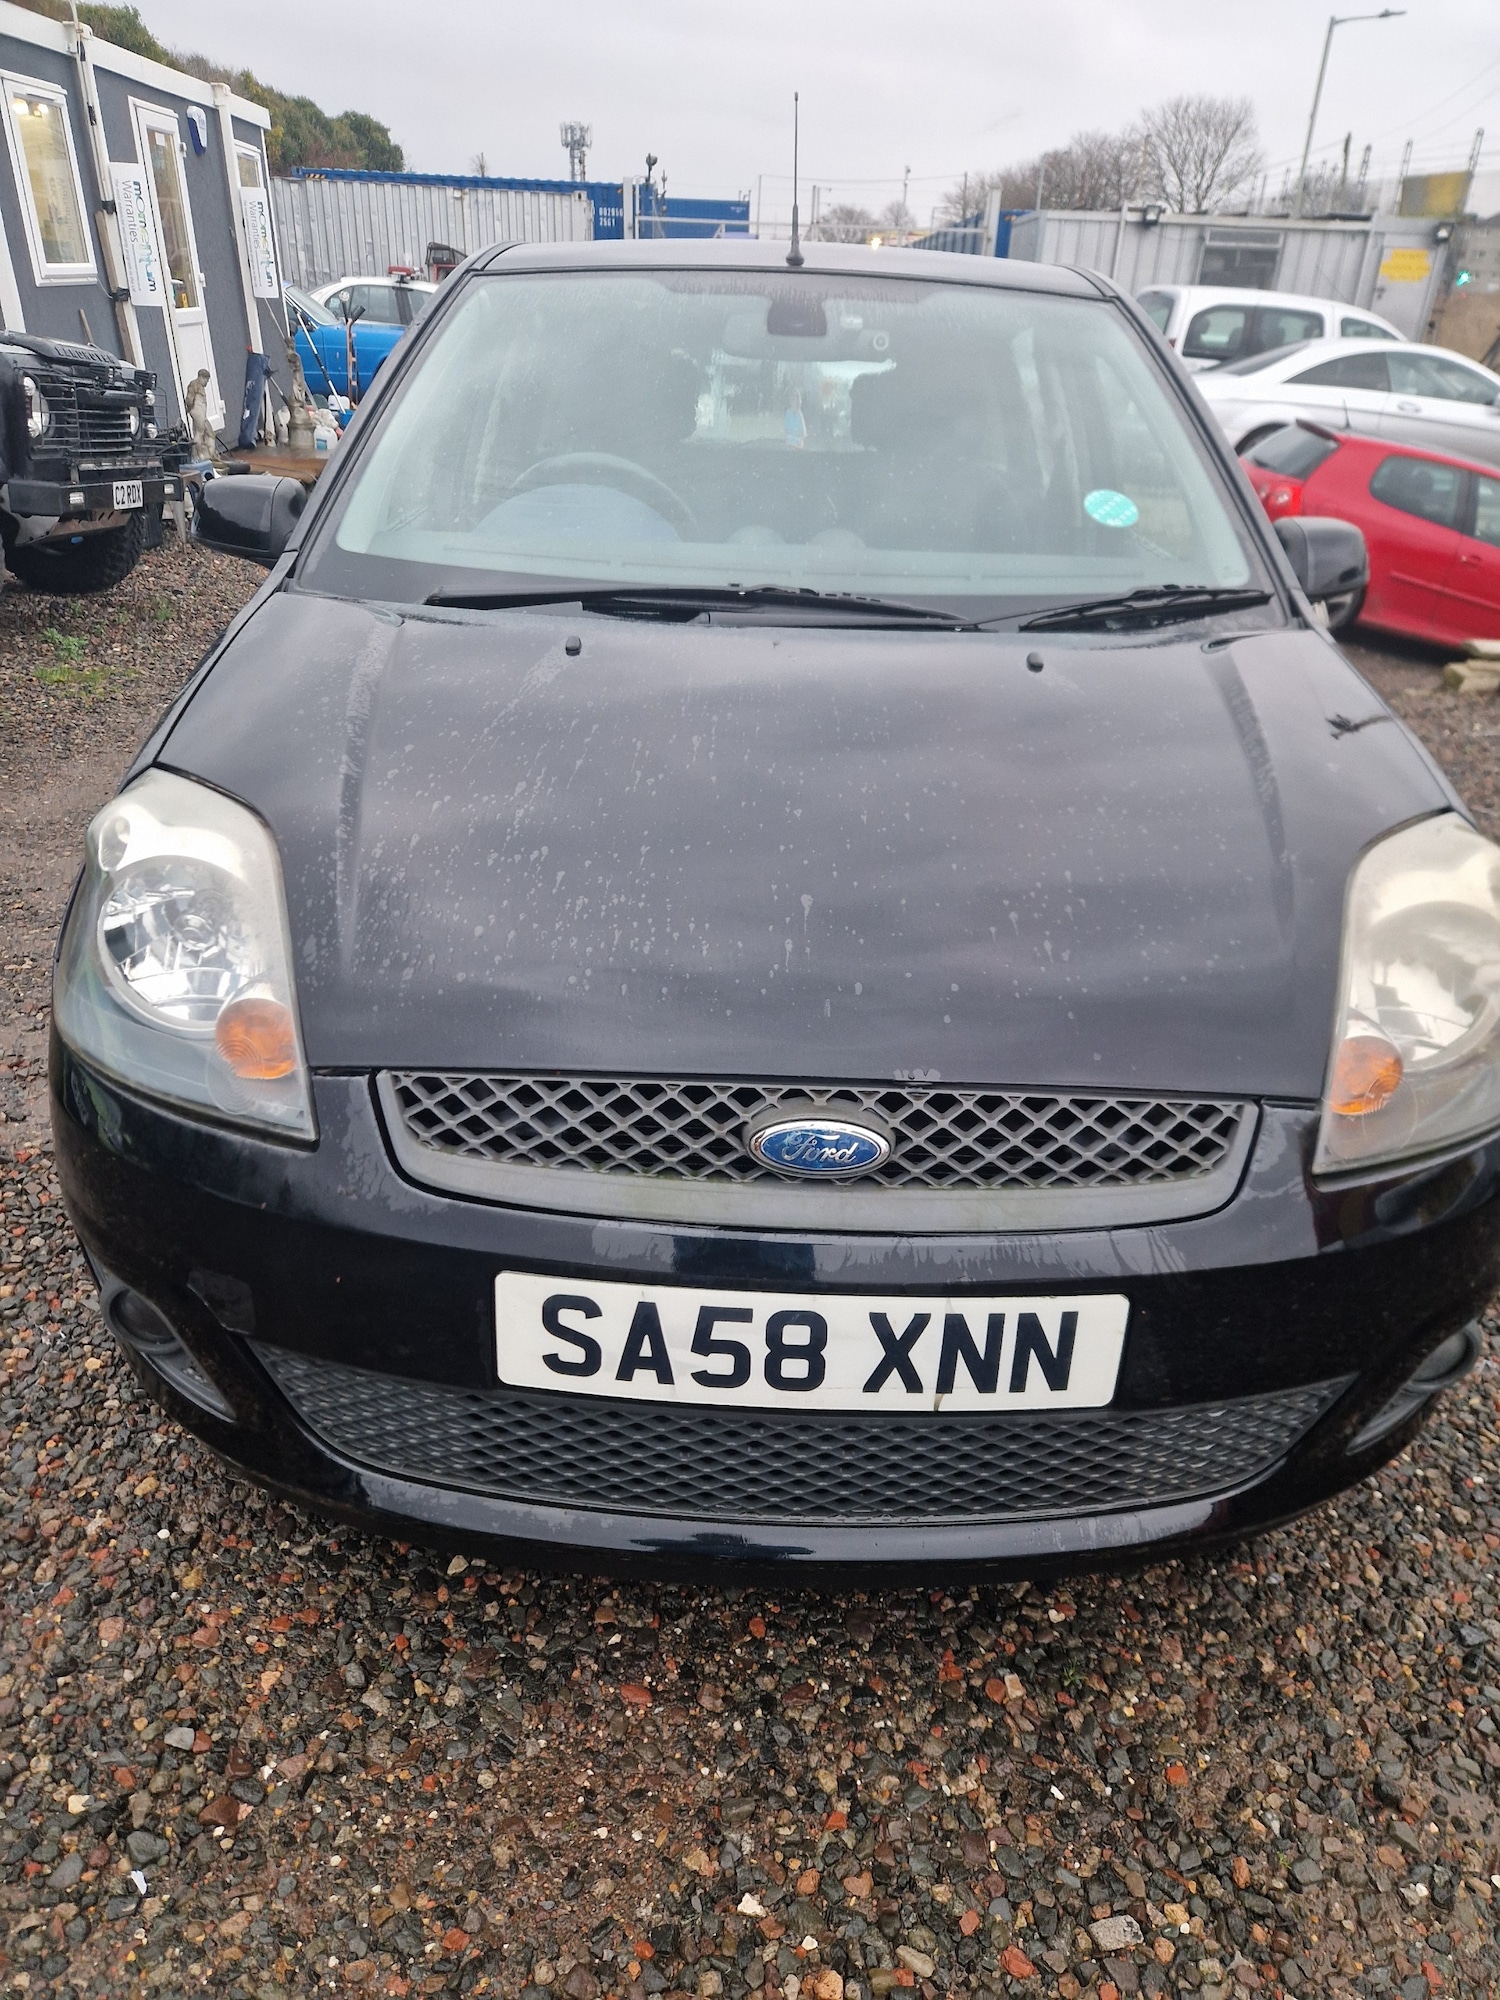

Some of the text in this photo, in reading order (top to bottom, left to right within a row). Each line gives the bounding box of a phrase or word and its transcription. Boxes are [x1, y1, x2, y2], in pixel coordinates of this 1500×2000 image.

[122, 180, 138, 243] Warranties
[248, 201, 260, 250] Warranties
[115, 484, 142, 505] C2 RDX
[780, 1130, 860, 1163] Ford
[541, 1294, 1079, 1394] SA58 XNN
